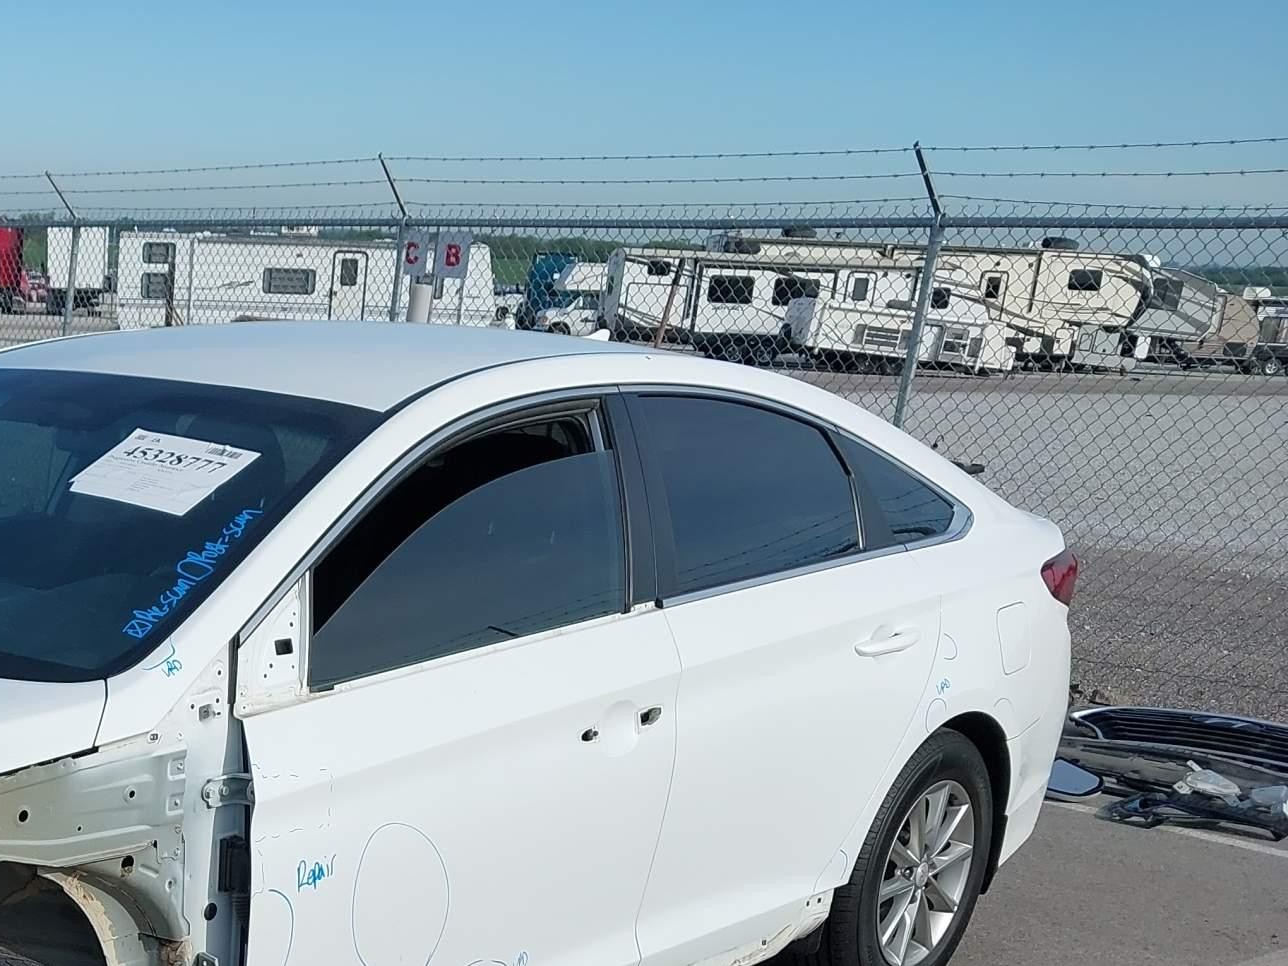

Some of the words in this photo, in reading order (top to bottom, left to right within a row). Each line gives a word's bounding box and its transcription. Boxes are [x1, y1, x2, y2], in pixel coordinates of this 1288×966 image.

[406, 241, 420, 265] C
[445, 244, 462, 267] B
[123, 446, 228, 474] 45328777
[297, 853, 337, 893] Repair
